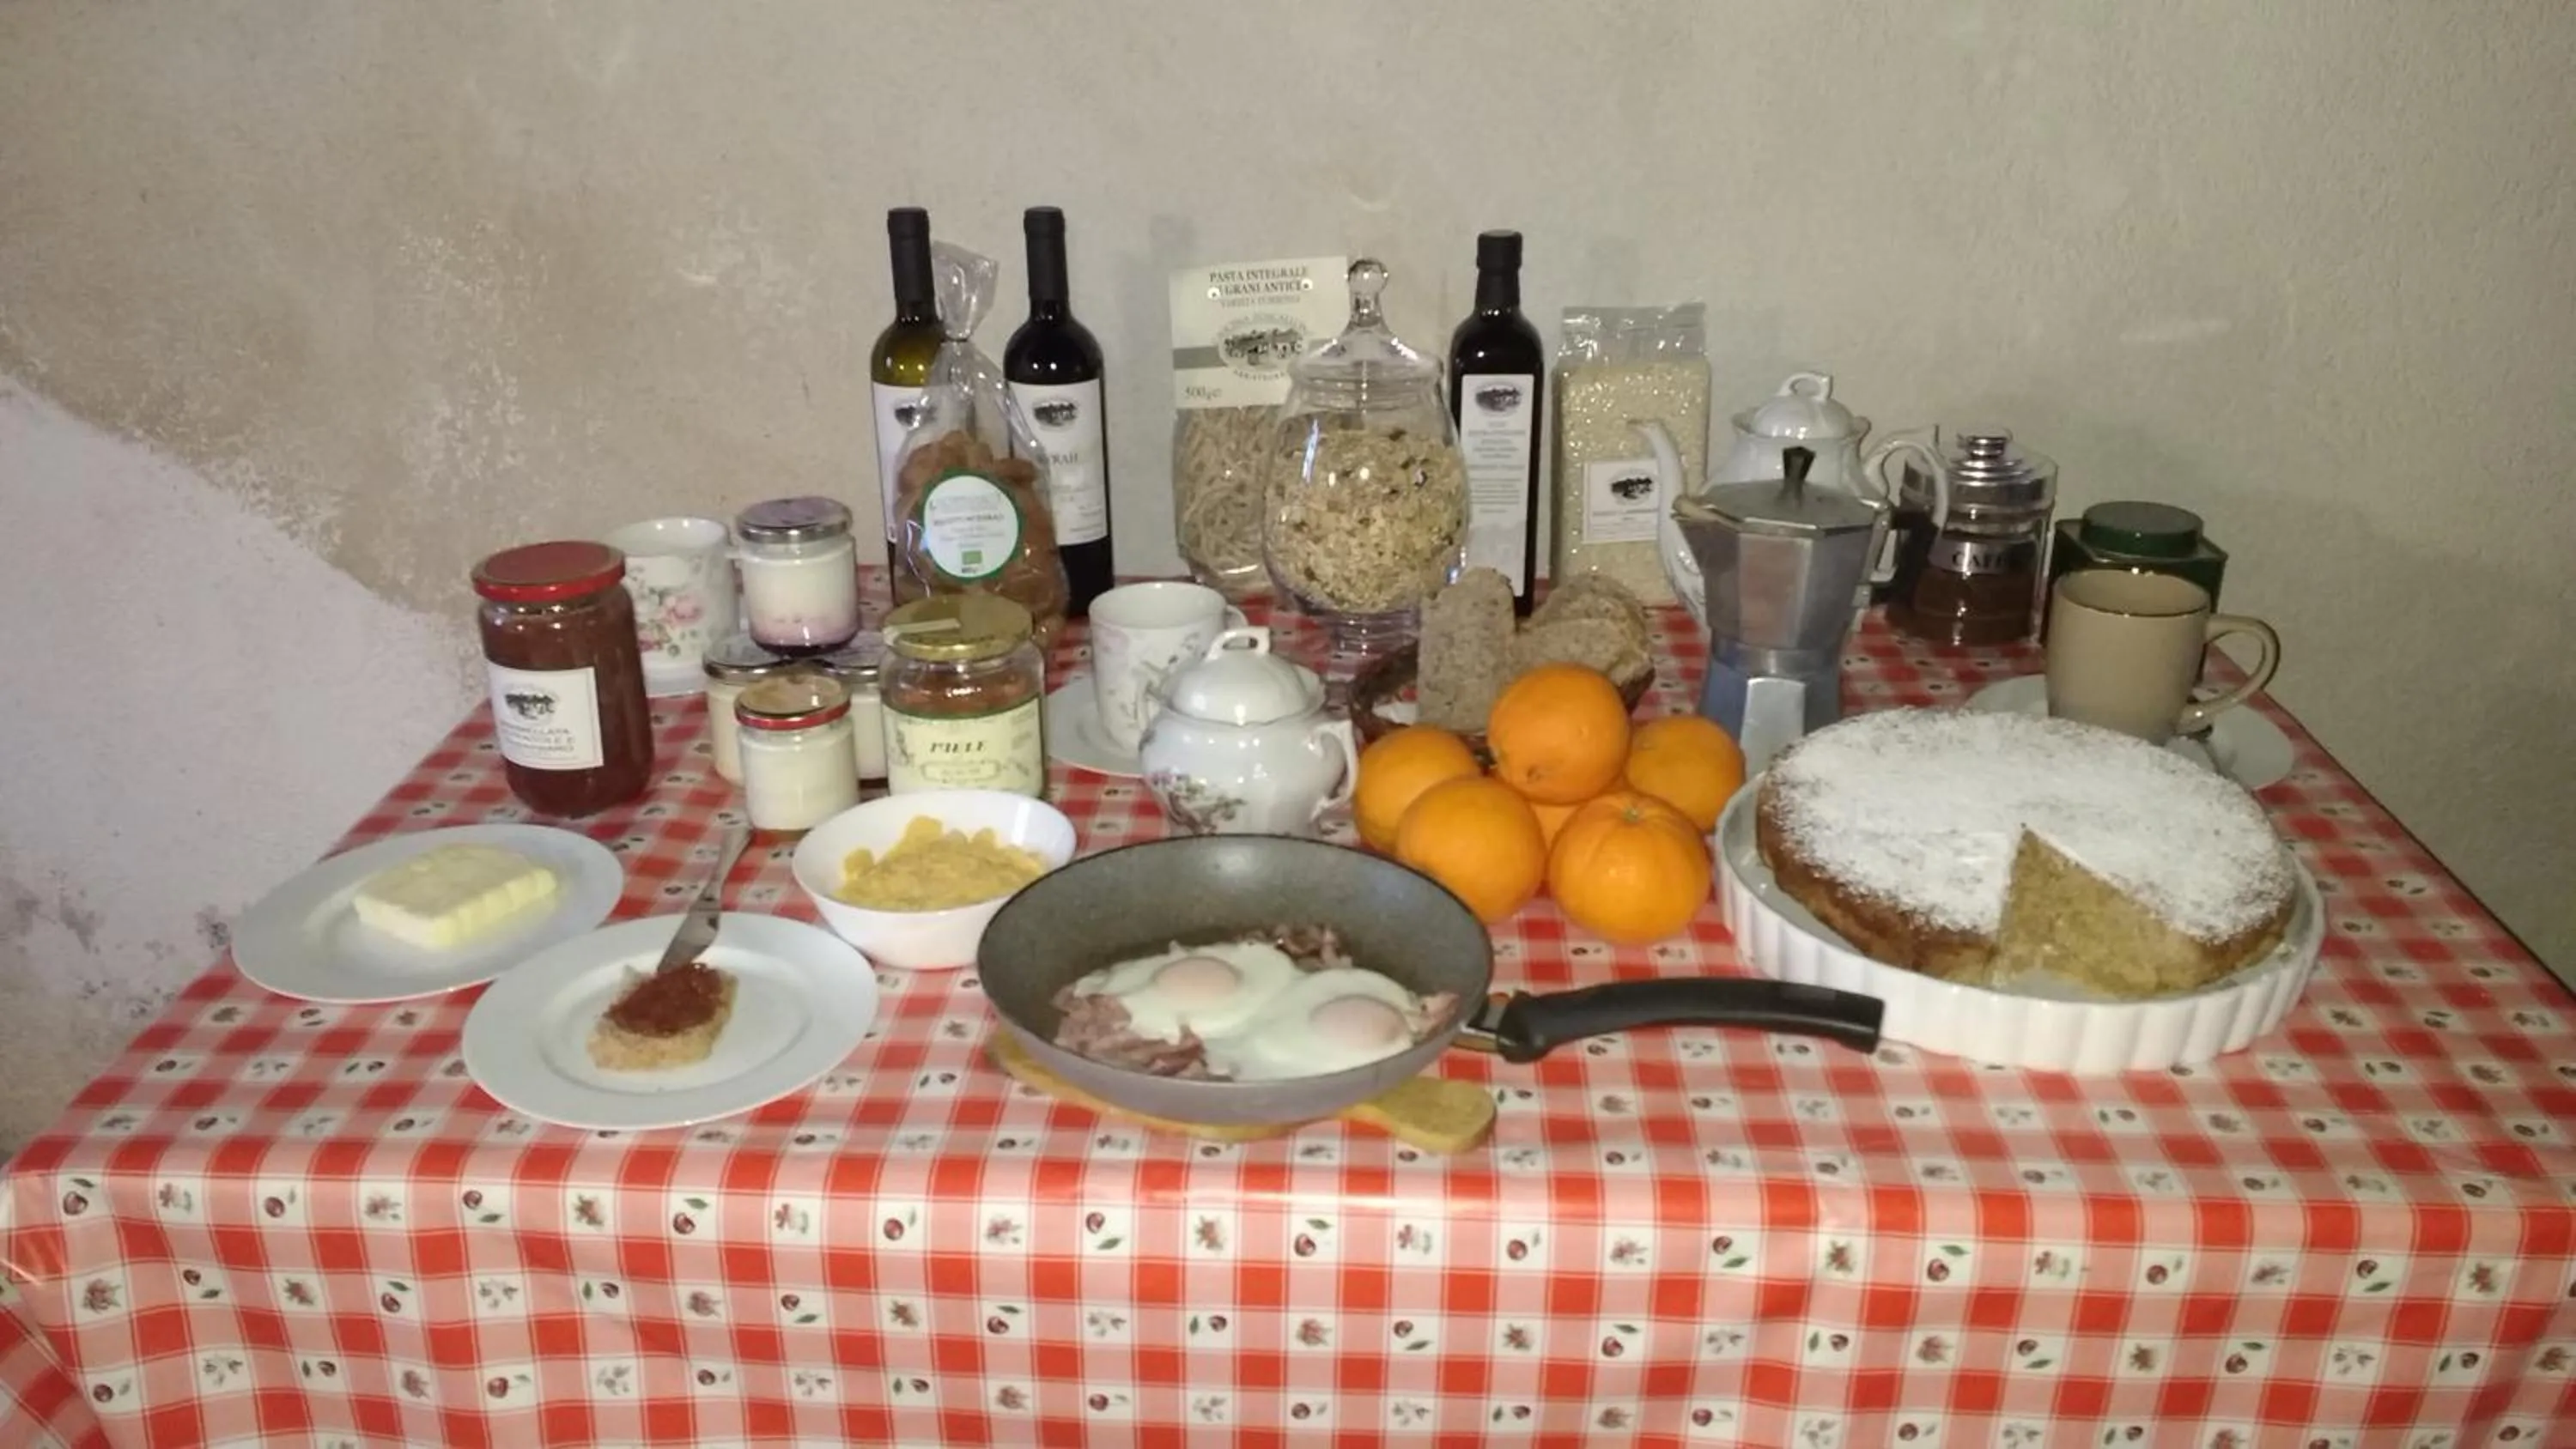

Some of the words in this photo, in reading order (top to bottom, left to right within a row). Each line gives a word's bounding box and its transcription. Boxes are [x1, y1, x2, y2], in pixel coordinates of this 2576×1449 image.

[1209, 270, 1244, 282] PASTA
[1246, 266, 1307, 281] INTEGRALE
[1224, 282, 1261, 296] GRANI
